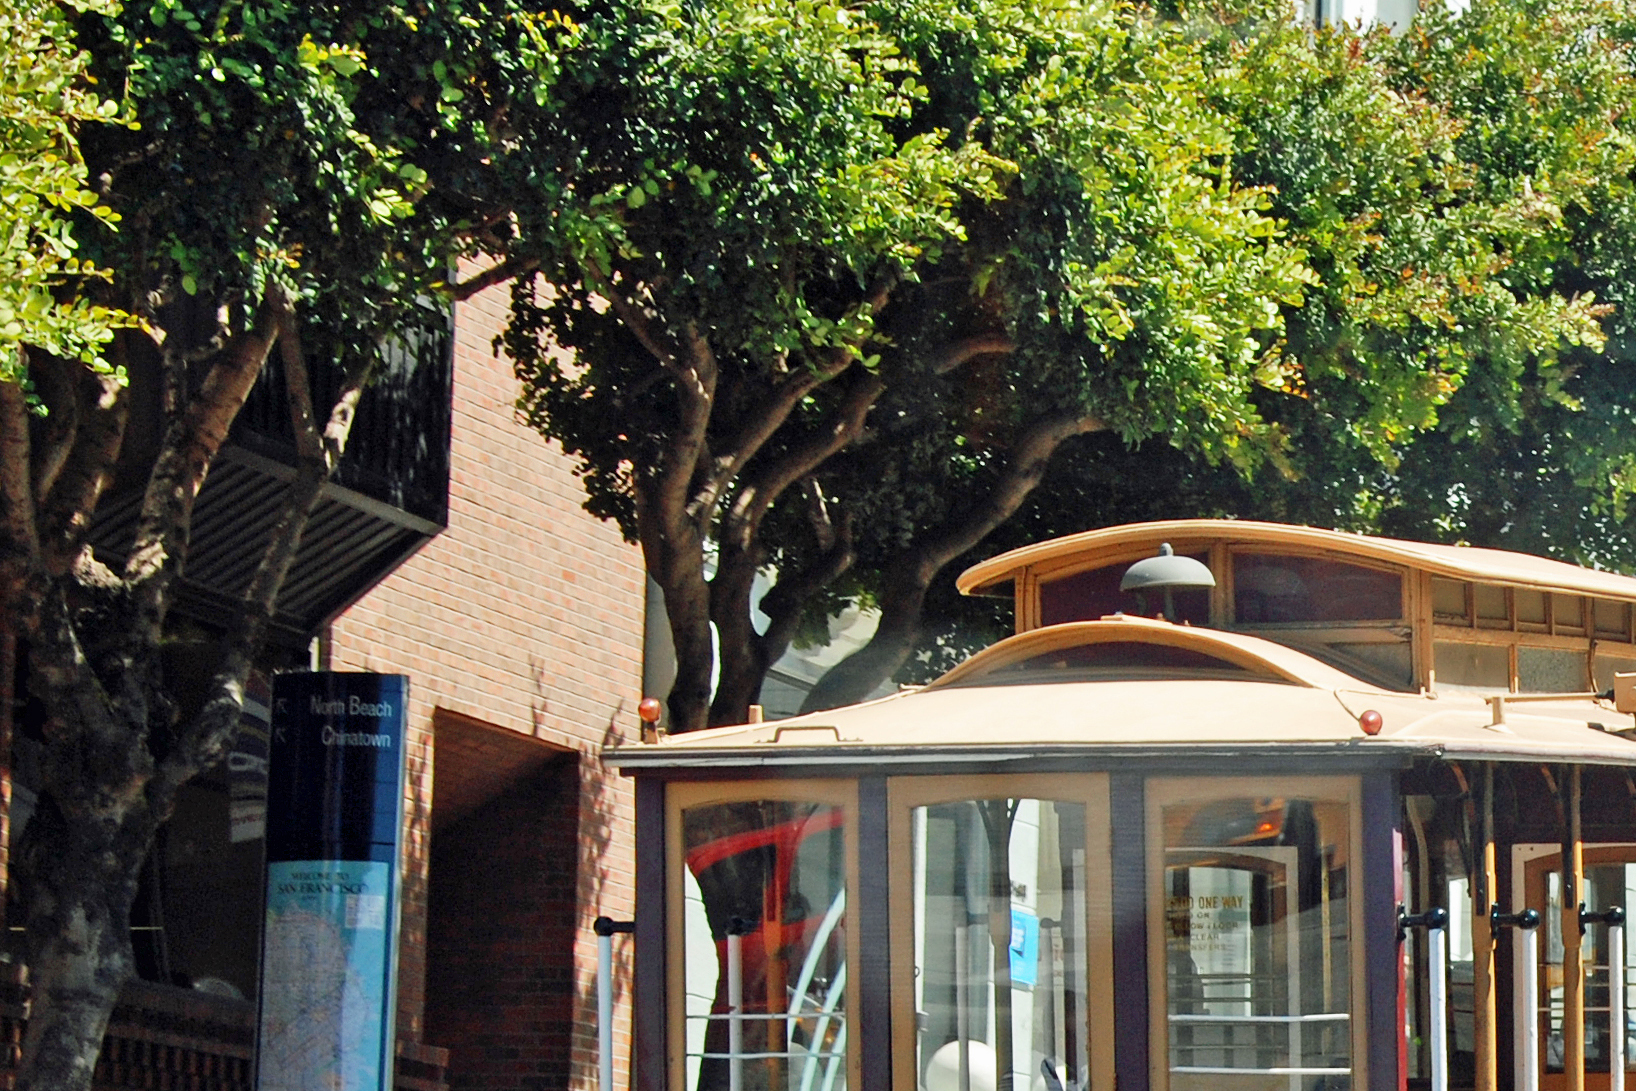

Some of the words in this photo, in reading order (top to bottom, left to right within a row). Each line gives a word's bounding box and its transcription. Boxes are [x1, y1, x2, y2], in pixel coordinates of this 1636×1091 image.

[309, 694, 346, 716] North
[348, 694, 393, 718] Beach
[321, 724, 392, 748] Chinatown
[1198, 895, 1219, 910] ONE
[1220, 894, 1244, 910] WAY
